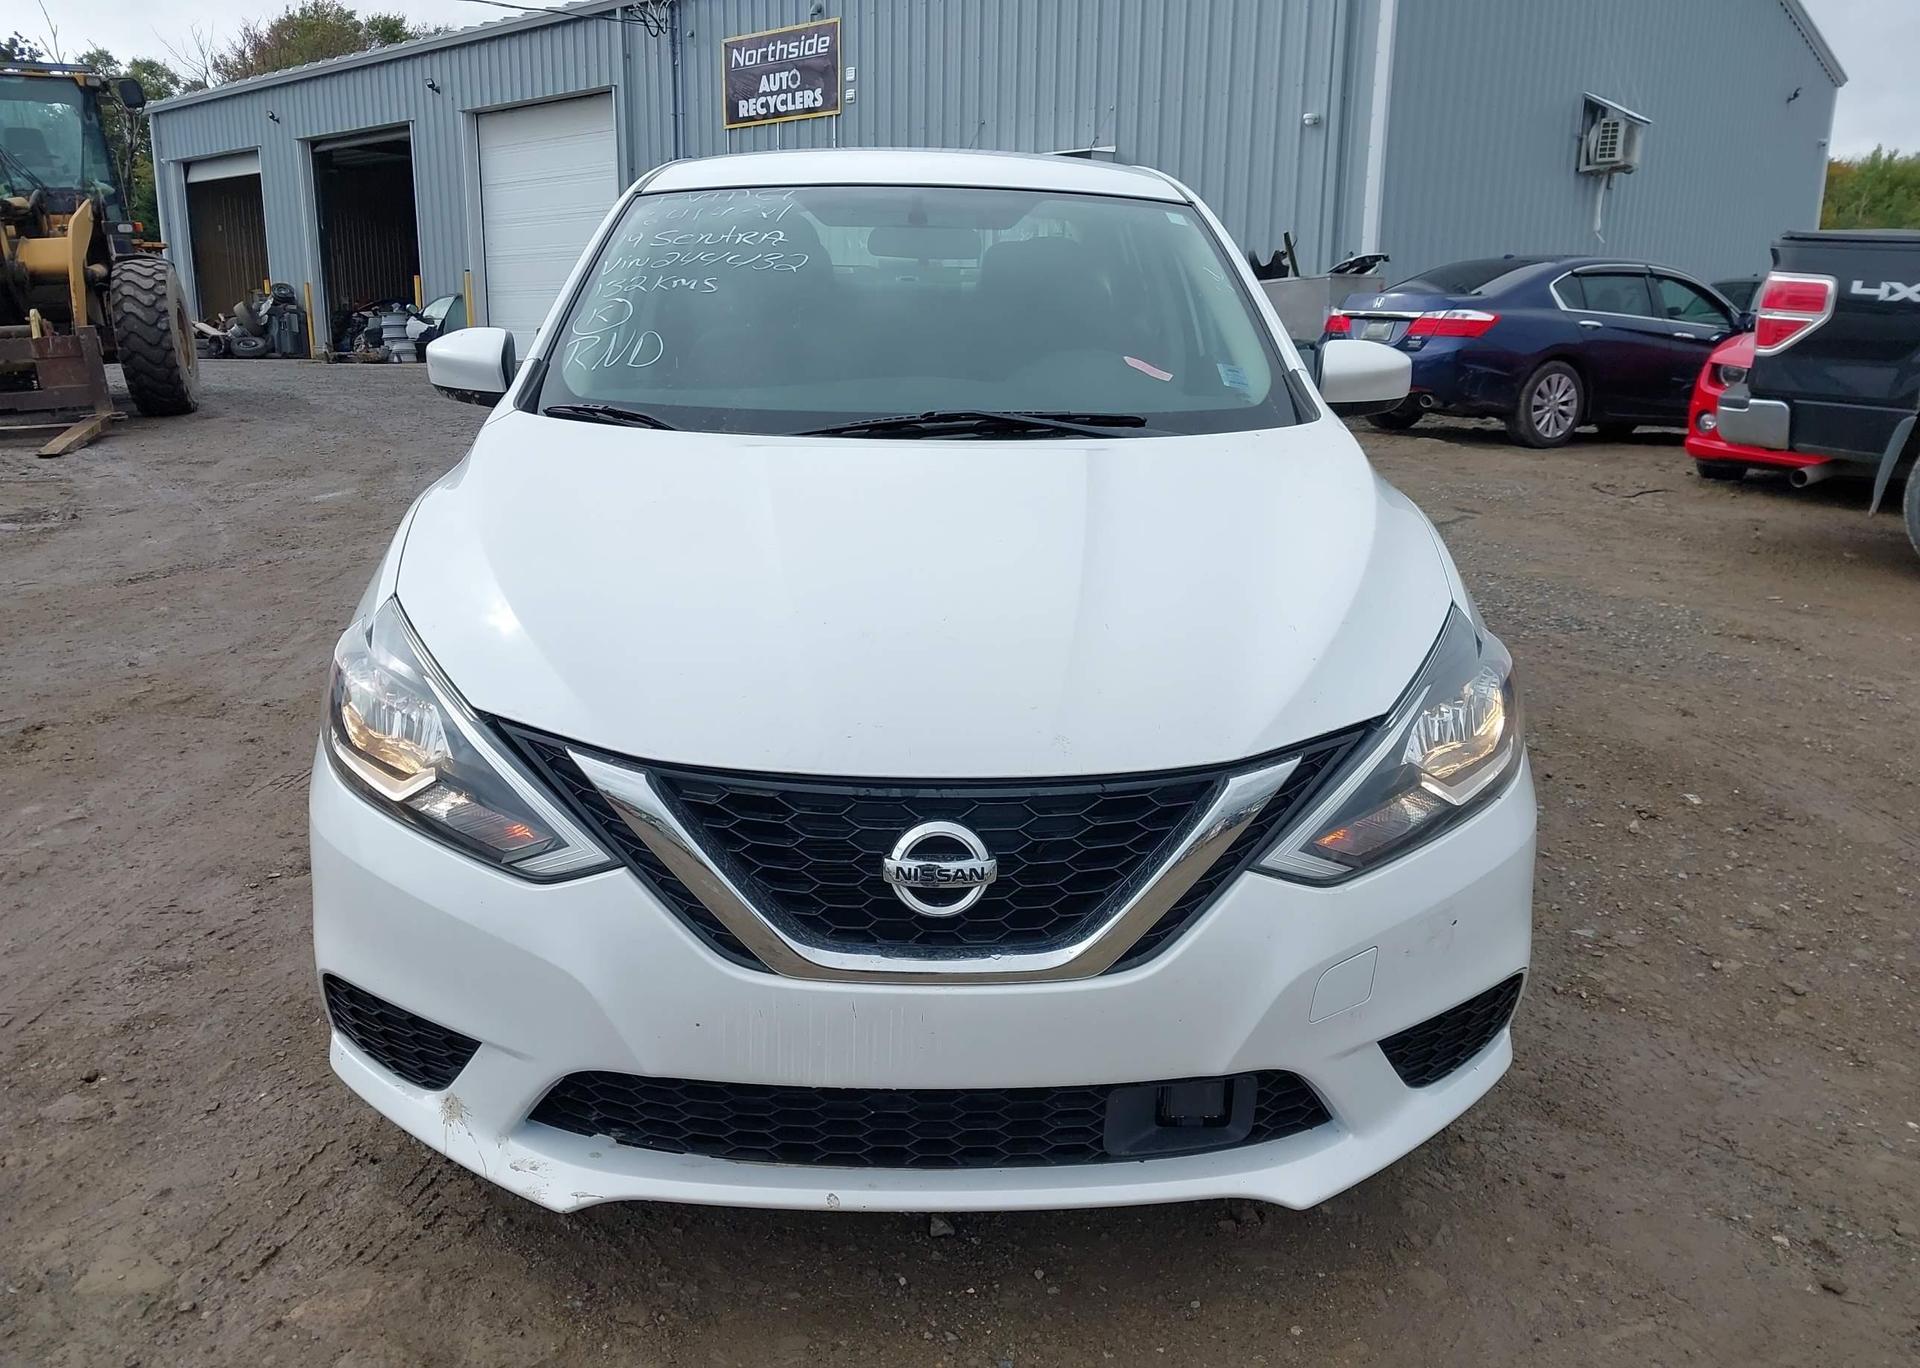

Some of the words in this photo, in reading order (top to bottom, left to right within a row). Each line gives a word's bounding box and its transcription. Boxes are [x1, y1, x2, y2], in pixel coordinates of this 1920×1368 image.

[731, 34, 830, 69] Northside
[758, 68, 801, 94] AUTO
[738, 88, 824, 118] RECYCLERS
[563, 329, 664, 371] RND
[895, 866, 985, 882] NISSAN
